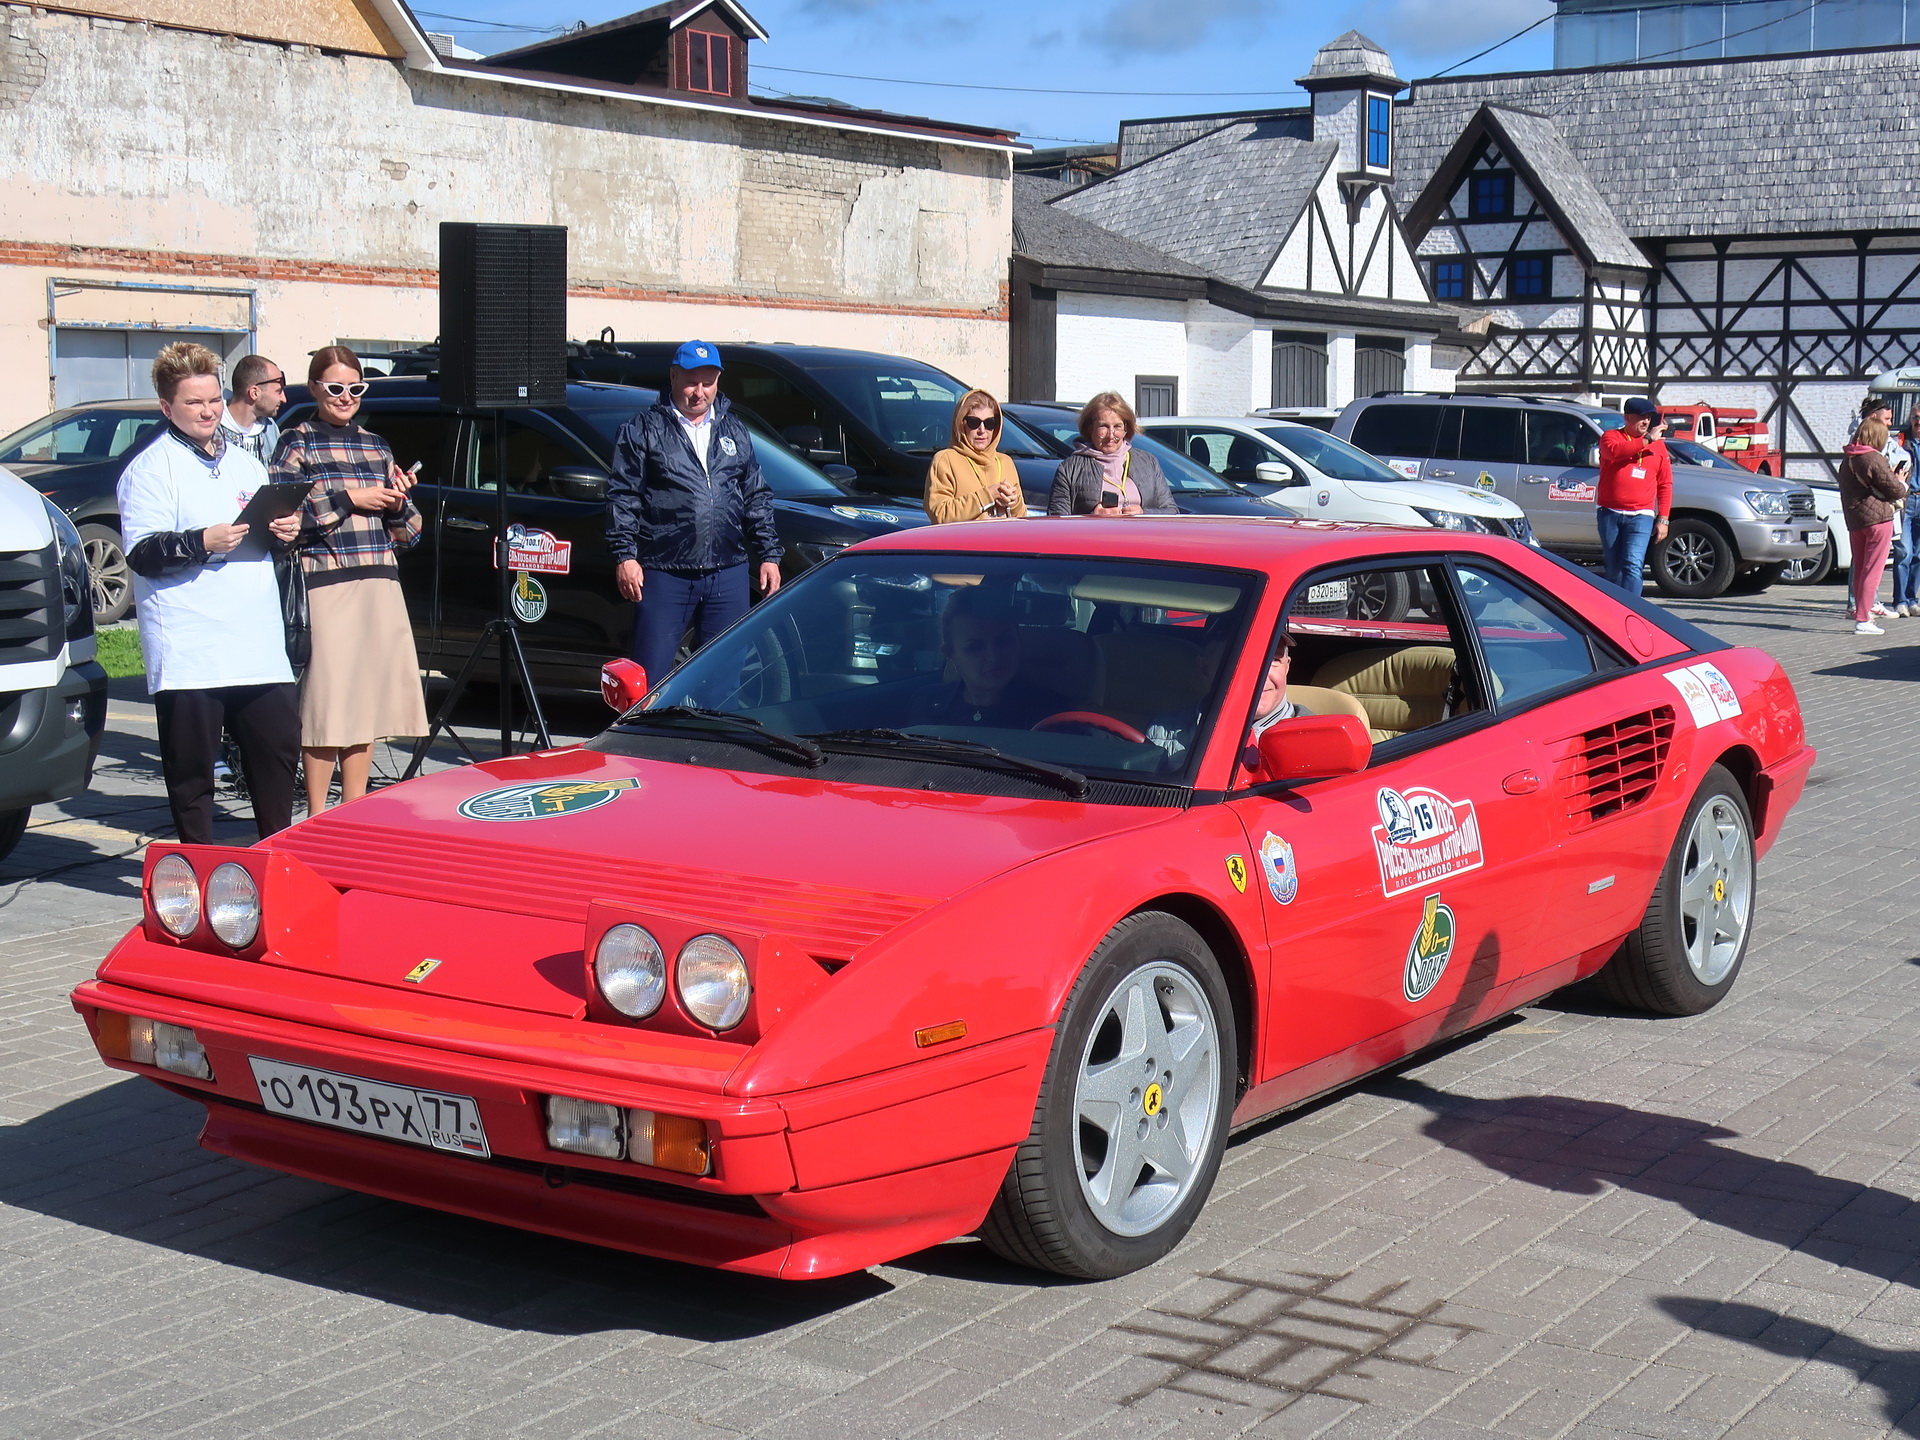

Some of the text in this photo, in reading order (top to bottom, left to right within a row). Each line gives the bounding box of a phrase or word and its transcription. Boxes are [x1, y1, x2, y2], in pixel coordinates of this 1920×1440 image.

[540, 533, 555, 553] 2021
[508, 547, 568, 566] ЕЛЬХОЗБАНК АВТОРАЛЛИ
[1414, 796, 1458, 835] 15 2021
[1378, 812, 1479, 880] РОССЕЛЬХОЗБАНК АВТОРАЛЛИ
[1416, 861, 1452, 882] ИВАНОВО
[422, 1096, 461, 1134] 77
[431, 1130, 462, 1147] RUS
